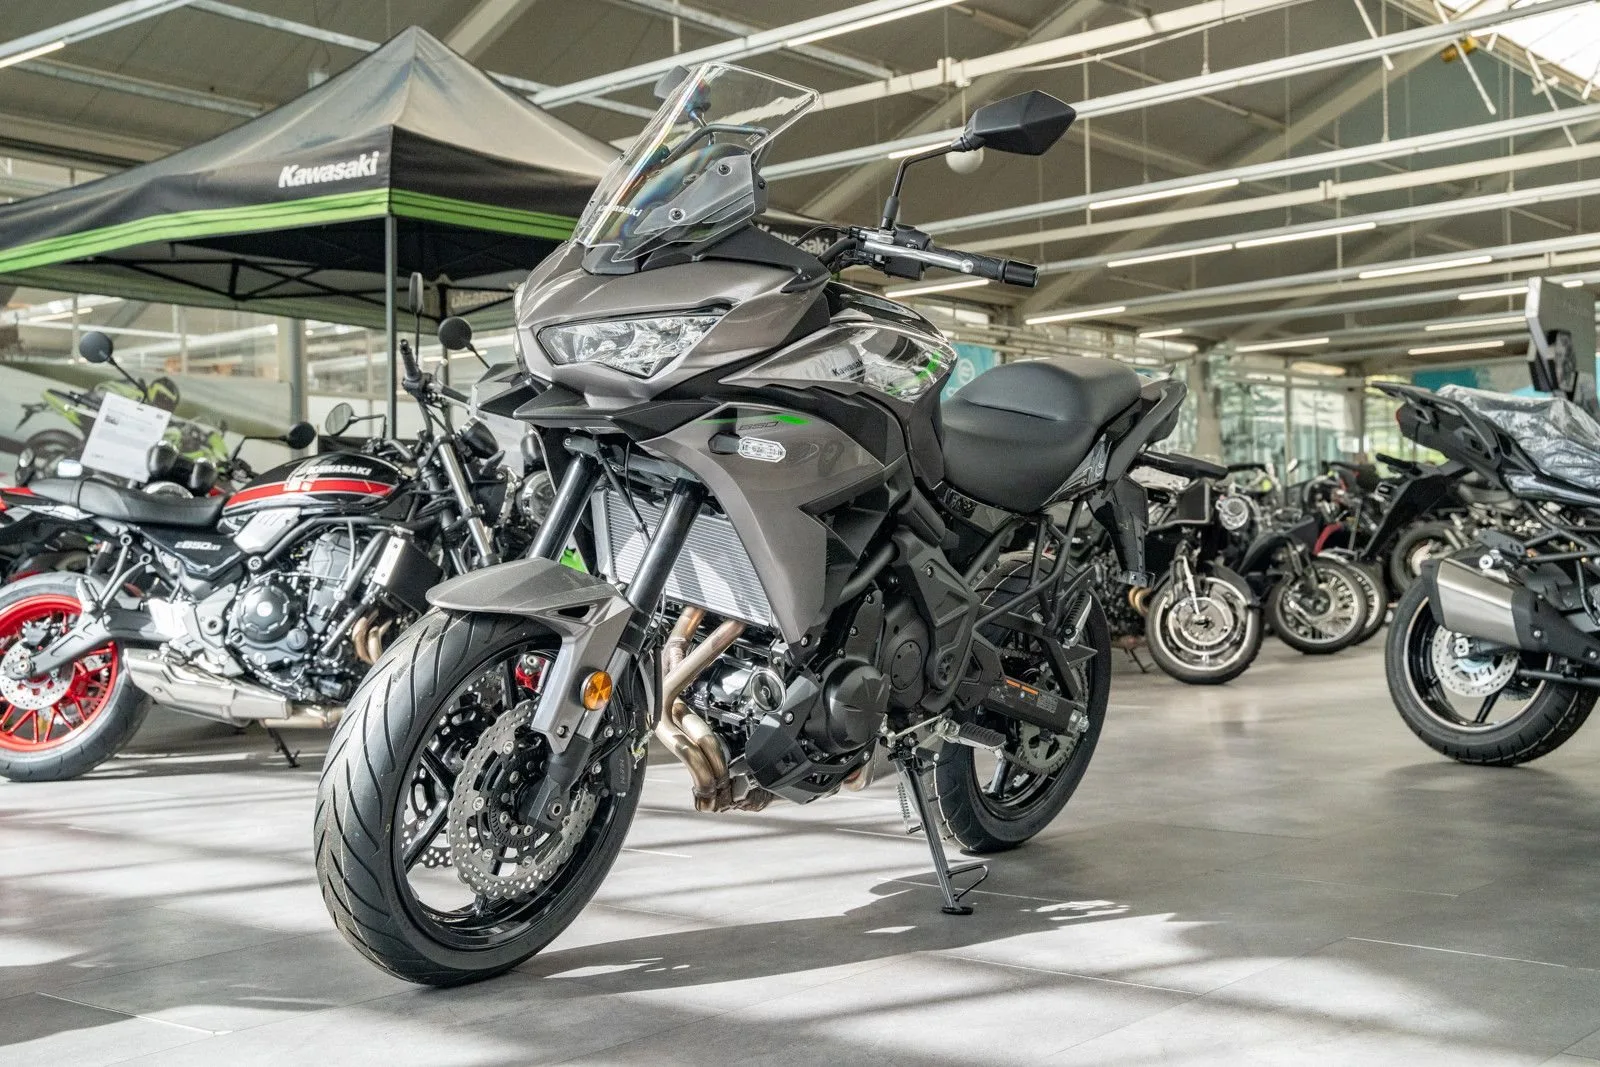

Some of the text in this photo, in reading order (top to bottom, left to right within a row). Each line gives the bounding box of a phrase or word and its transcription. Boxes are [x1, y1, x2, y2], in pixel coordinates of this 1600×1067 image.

[278, 150, 379, 188] Kawasaki
[598, 205, 643, 217] Kaasaki
[307, 465, 373, 476] KAWASAKI
